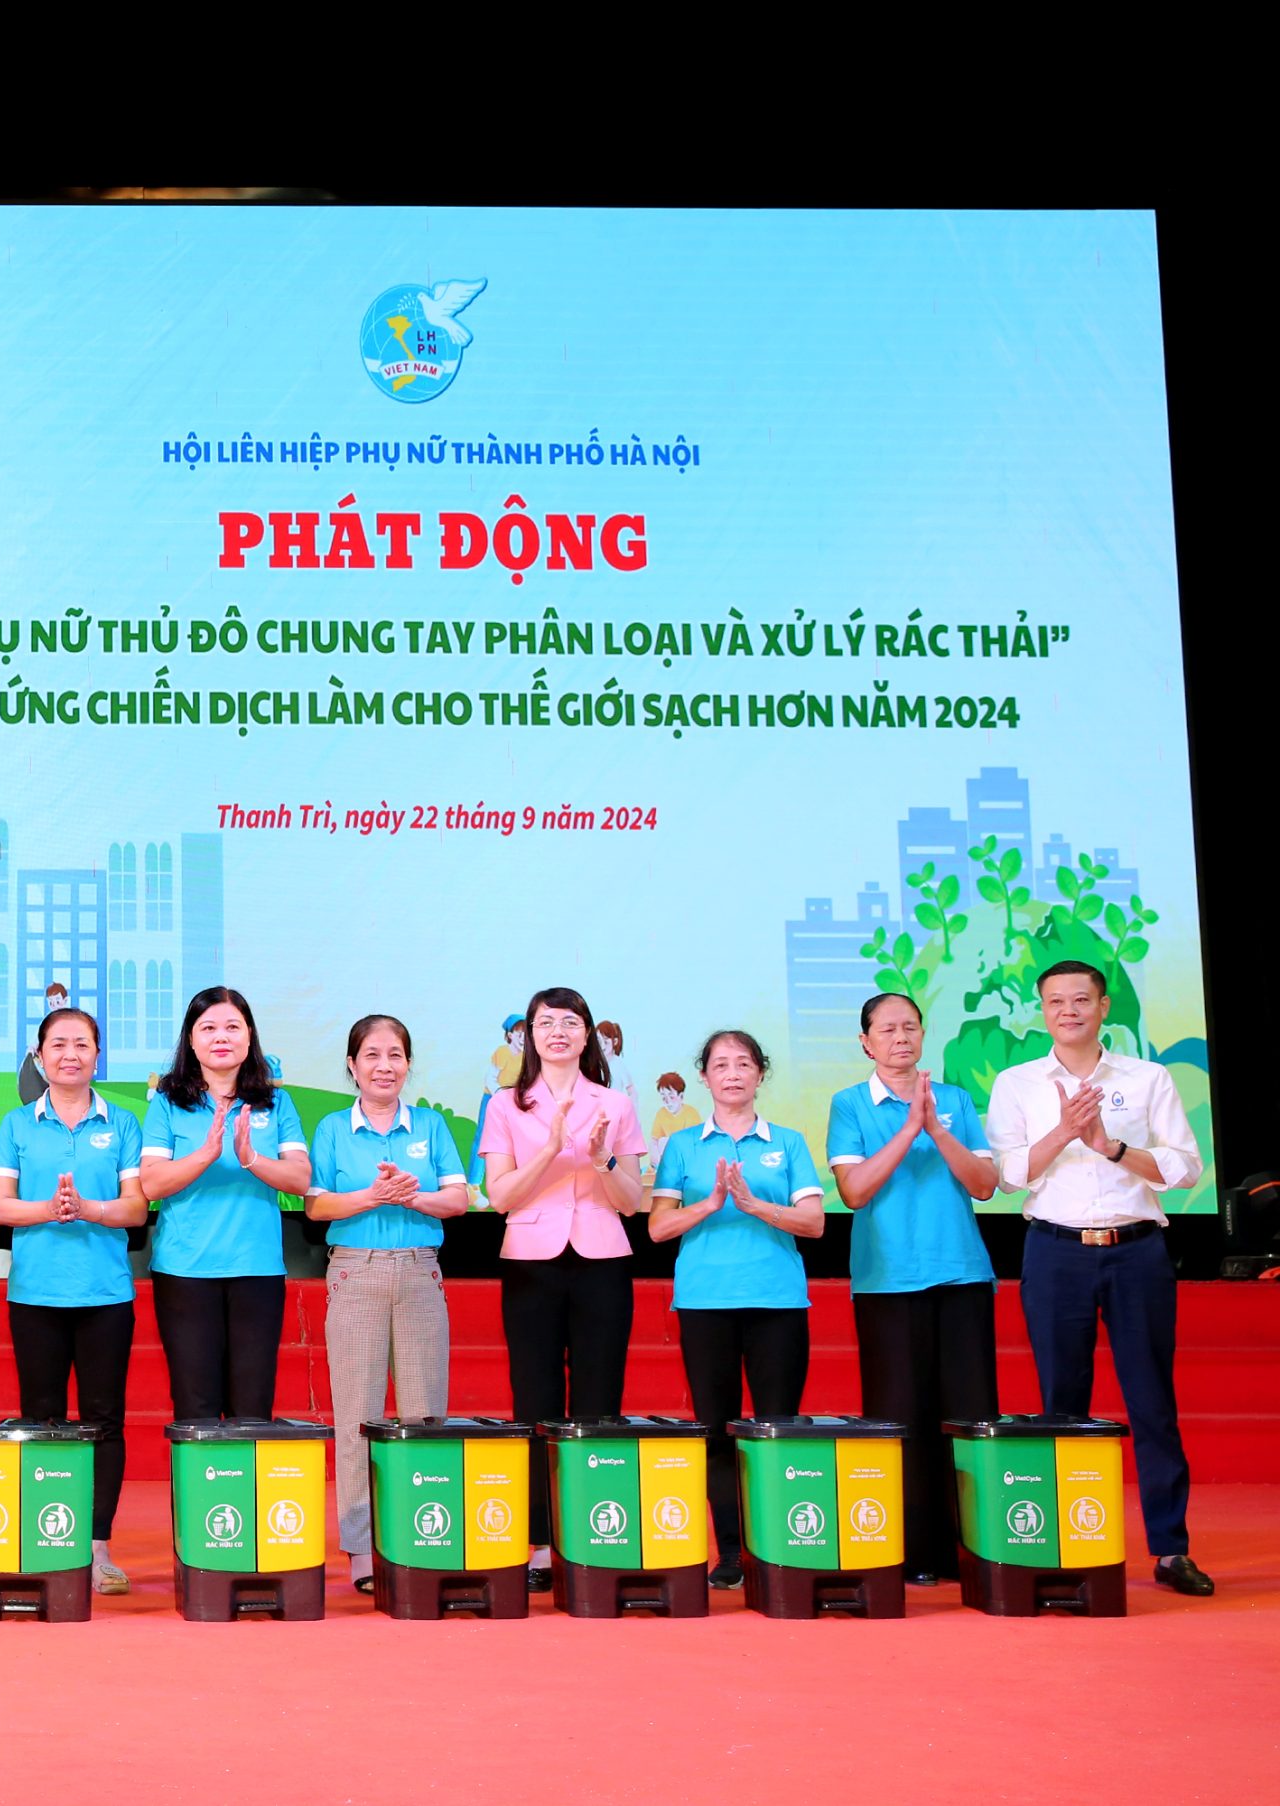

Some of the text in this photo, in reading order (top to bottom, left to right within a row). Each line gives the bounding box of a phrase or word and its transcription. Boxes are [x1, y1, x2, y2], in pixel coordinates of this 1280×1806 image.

[383, 362, 437, 375] VIET NAM
[163, 427, 700, 474] HỘI LIÊN HIỆP PHỤ NỮ THÀNH PHỐ HÀ NỘI
[219, 494, 647, 586] PHÁT ĐỘNG
[31, 608, 91, 653] NỮ
[98, 605, 179, 653] THỦ
[187, 605, 248, 654] ĐÔ
[258, 619, 395, 654] CHUNG
[404, 621, 474, 654] TAY
[485, 607, 593, 656] PHÂN
[605, 622, 691, 668] LOẠI
[702, 608, 753, 656] VÀ
[763, 608, 815, 657] XỬ
[824, 609, 864, 657] LÝ
[876, 610, 949, 657] RÁC
[959, 610, 1070, 657] THẢI”
[0, 675, 80, 725] ỨNG
[87, 667, 200, 725] CHIẾN
[209, 691, 300, 737] DỊCH
[309, 676, 384, 725] LÀM
[393, 691, 472, 725] CHO
[479, 668, 550, 726] THẾ
[558, 678, 635, 726] GIỚI
[643, 693, 739, 737] SẠCH
[749, 692, 833, 728] HƠN
[843, 683, 927, 728] NĂM
[936, 695, 1019, 728] 2024
[219, 801, 657, 836] Thanh Trì, ngày 22 tháng 9 năm 2024
